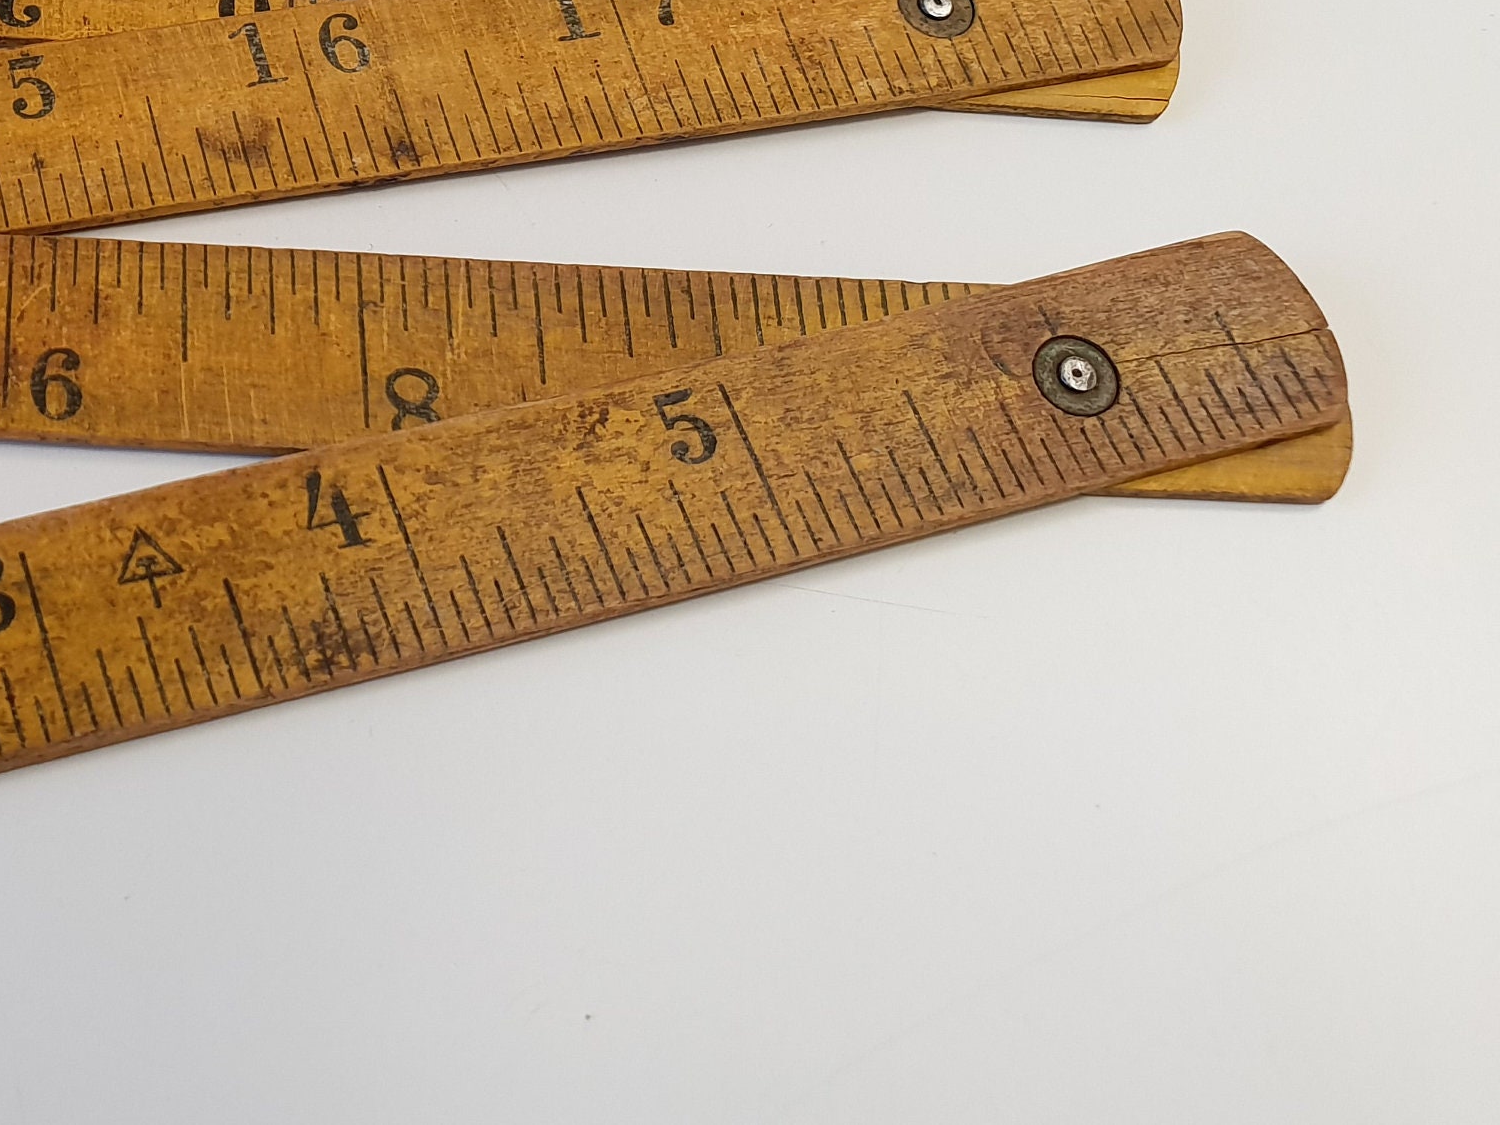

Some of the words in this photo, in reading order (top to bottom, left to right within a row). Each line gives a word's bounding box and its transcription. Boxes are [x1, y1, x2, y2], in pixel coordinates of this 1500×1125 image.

[229, 13, 371, 87] 16
[30, 347, 83, 421] 9
[654, 388, 717, 465] 5
[306, 471, 370, 549] 4
